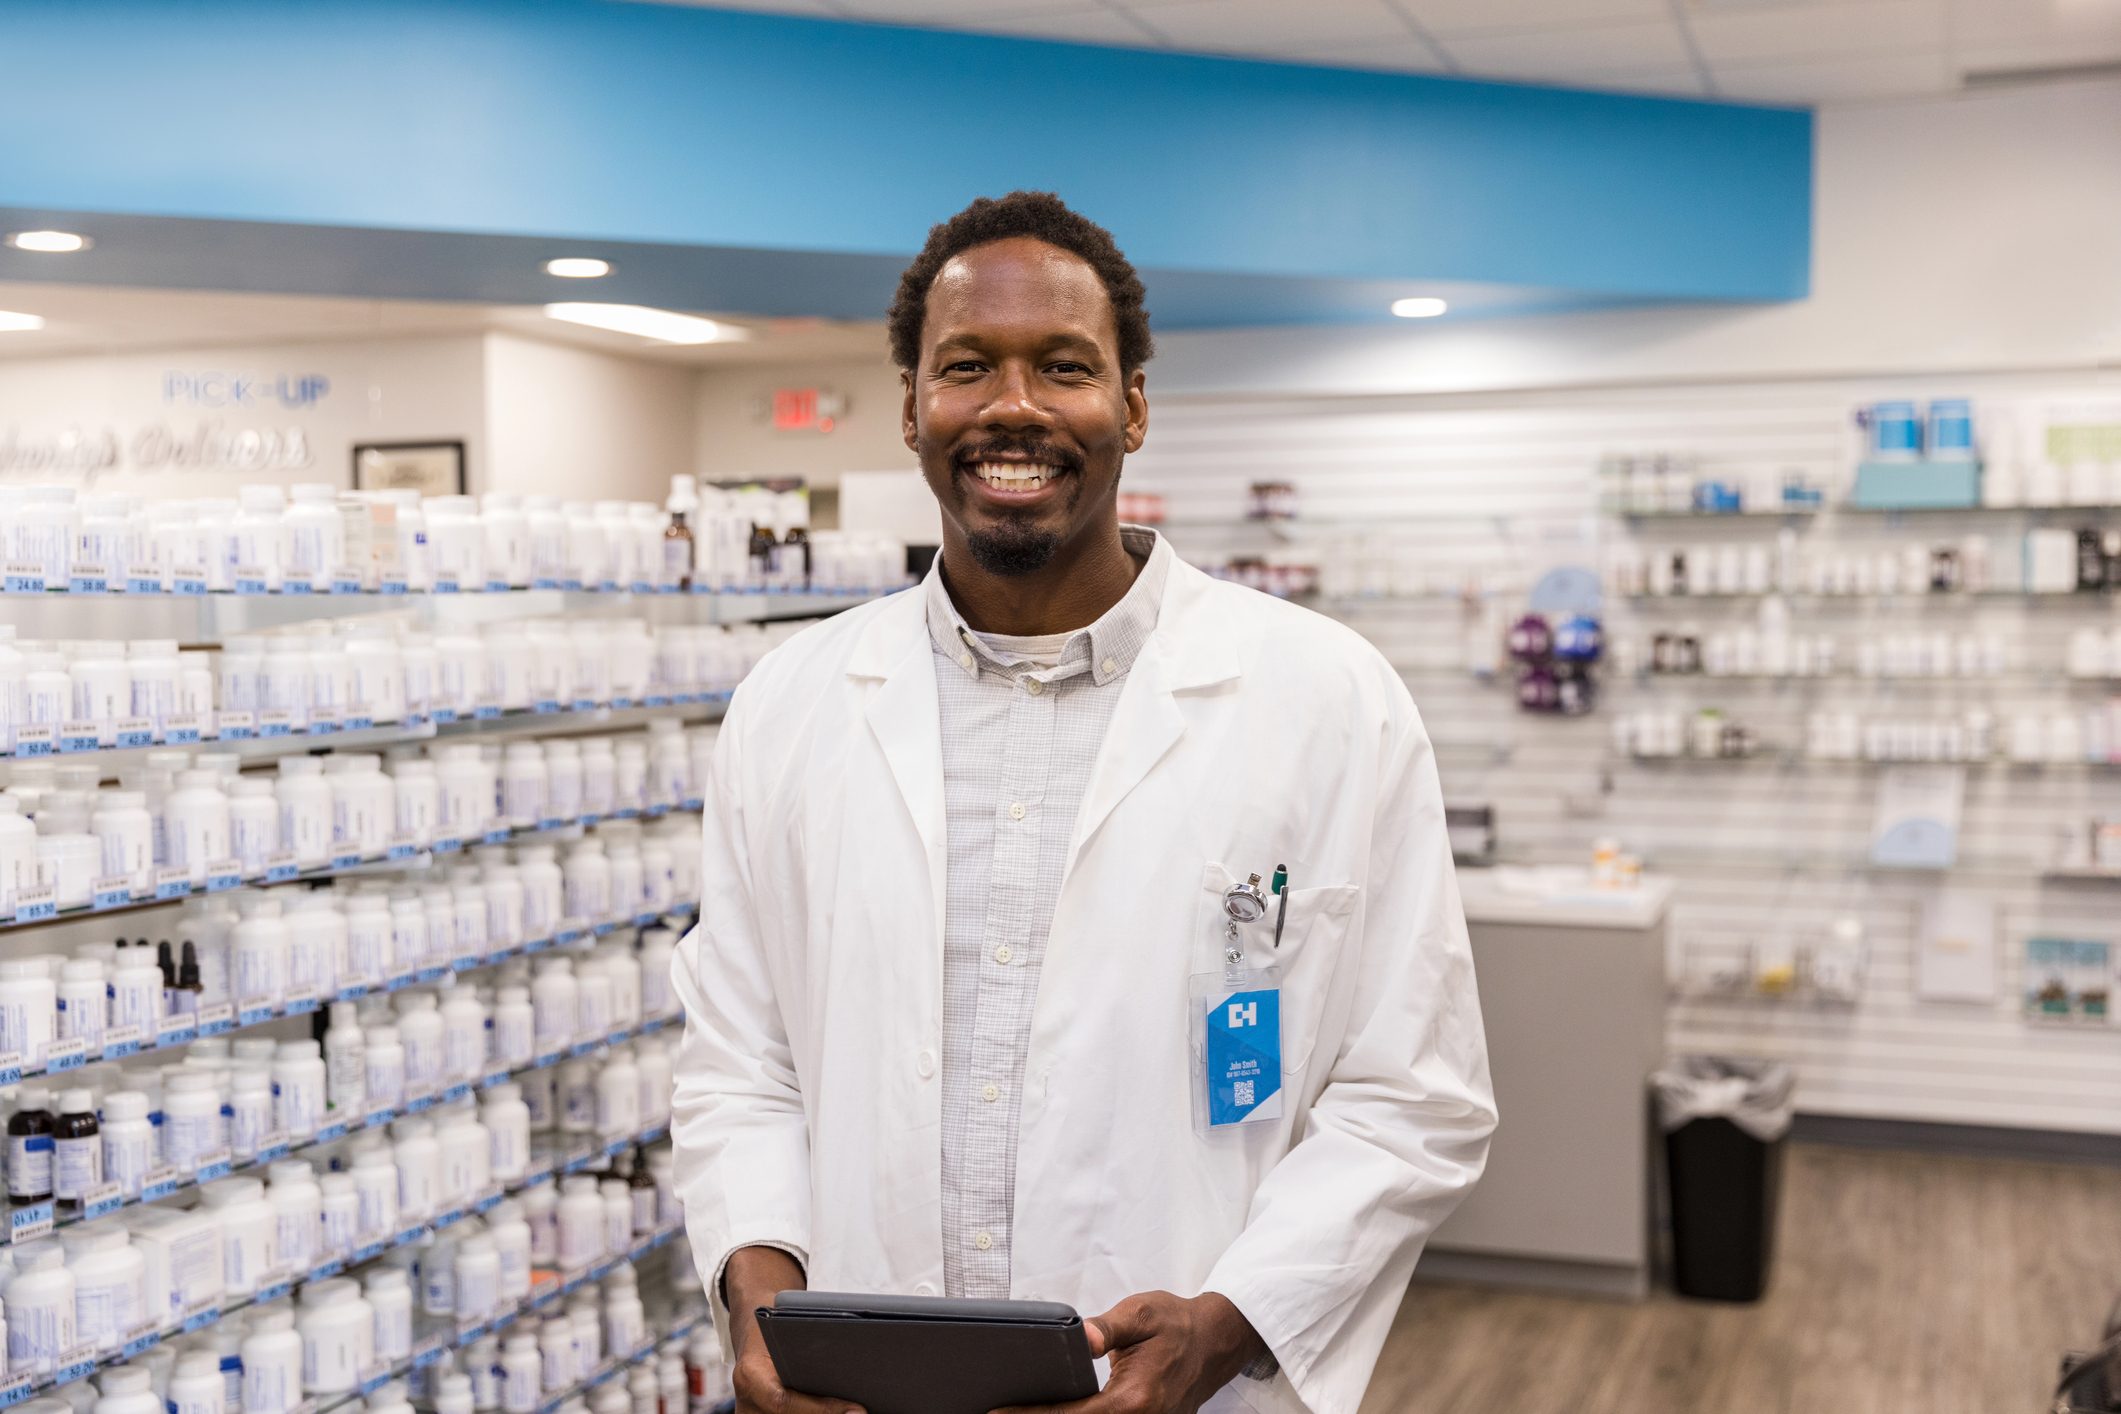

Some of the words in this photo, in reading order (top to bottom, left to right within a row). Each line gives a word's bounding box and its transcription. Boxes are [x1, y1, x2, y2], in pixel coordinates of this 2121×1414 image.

[162, 370, 330, 410] PICK-UP
[1229, 1061, 1241, 1070] John
[1242, 1059, 1257, 1069] Smith
